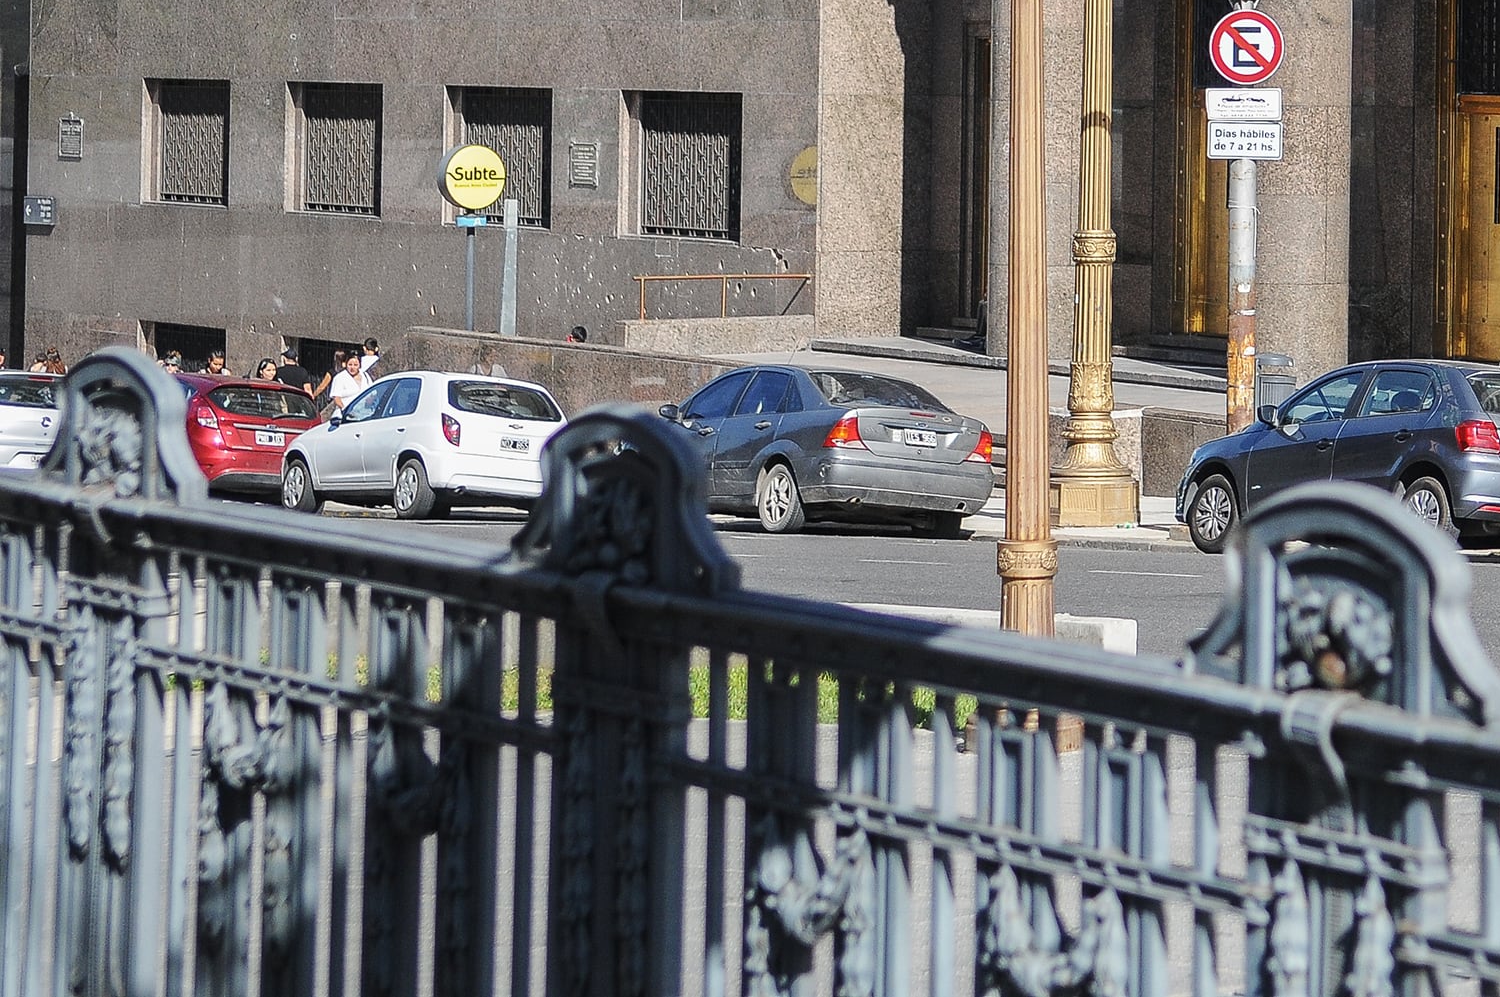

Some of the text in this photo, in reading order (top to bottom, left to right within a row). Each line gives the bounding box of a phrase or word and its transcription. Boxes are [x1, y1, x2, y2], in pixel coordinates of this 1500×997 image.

[1214, 142, 1226, 151] de
[1229, 142, 1235, 151] 7
[1246, 143, 1257, 151] 21
[451, 166, 502, 181] Subte
